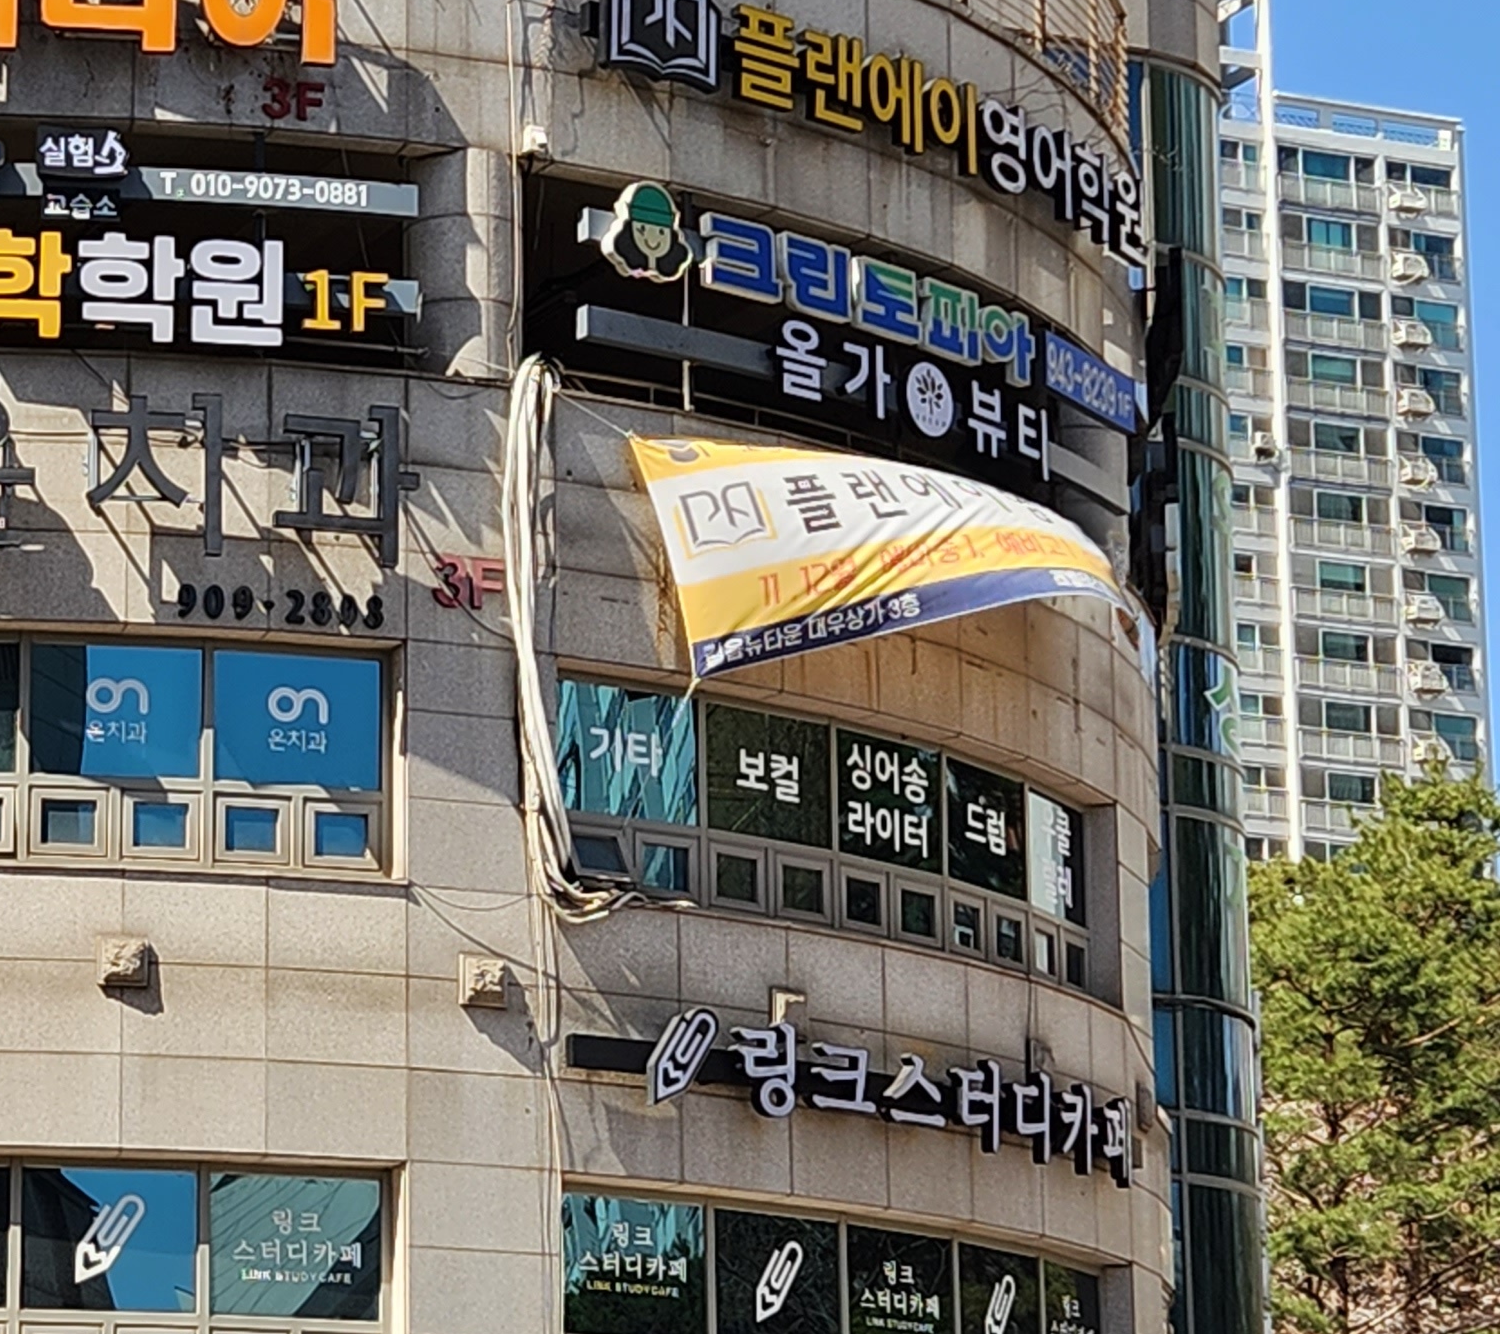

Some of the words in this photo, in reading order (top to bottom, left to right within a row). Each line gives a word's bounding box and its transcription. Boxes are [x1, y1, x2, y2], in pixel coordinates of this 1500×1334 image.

[261, 76, 326, 121] 3F
[43, 193, 118, 220] 교습소
[190, 172, 368, 208] 010-9073-0881
[301, 269, 390, 332] 1F
[700, 211, 1035, 389] 크린토피아
[776, 318, 892, 421] 올가
[967, 380, 1051, 482] 뷰티
[431, 554, 506, 610] 3F
[85, 719, 148, 745] 온치과
[267, 727, 328, 755] 온치과
[589, 726, 664, 776] 기타
[736, 747, 801, 805] 보컬
[846, 742, 930, 806] 싱어송
[846, 799, 930, 859] 라이터
[964, 801, 1007, 857] 드럼
[729, 1021, 1134, 1189] 링크스터디카페
[271, 1207, 322, 1235] 링크
[612, 1220, 655, 1248] 링크
[231, 1237, 363, 1270] 스터디카페
[578, 1250, 688, 1284] 스터디카페
